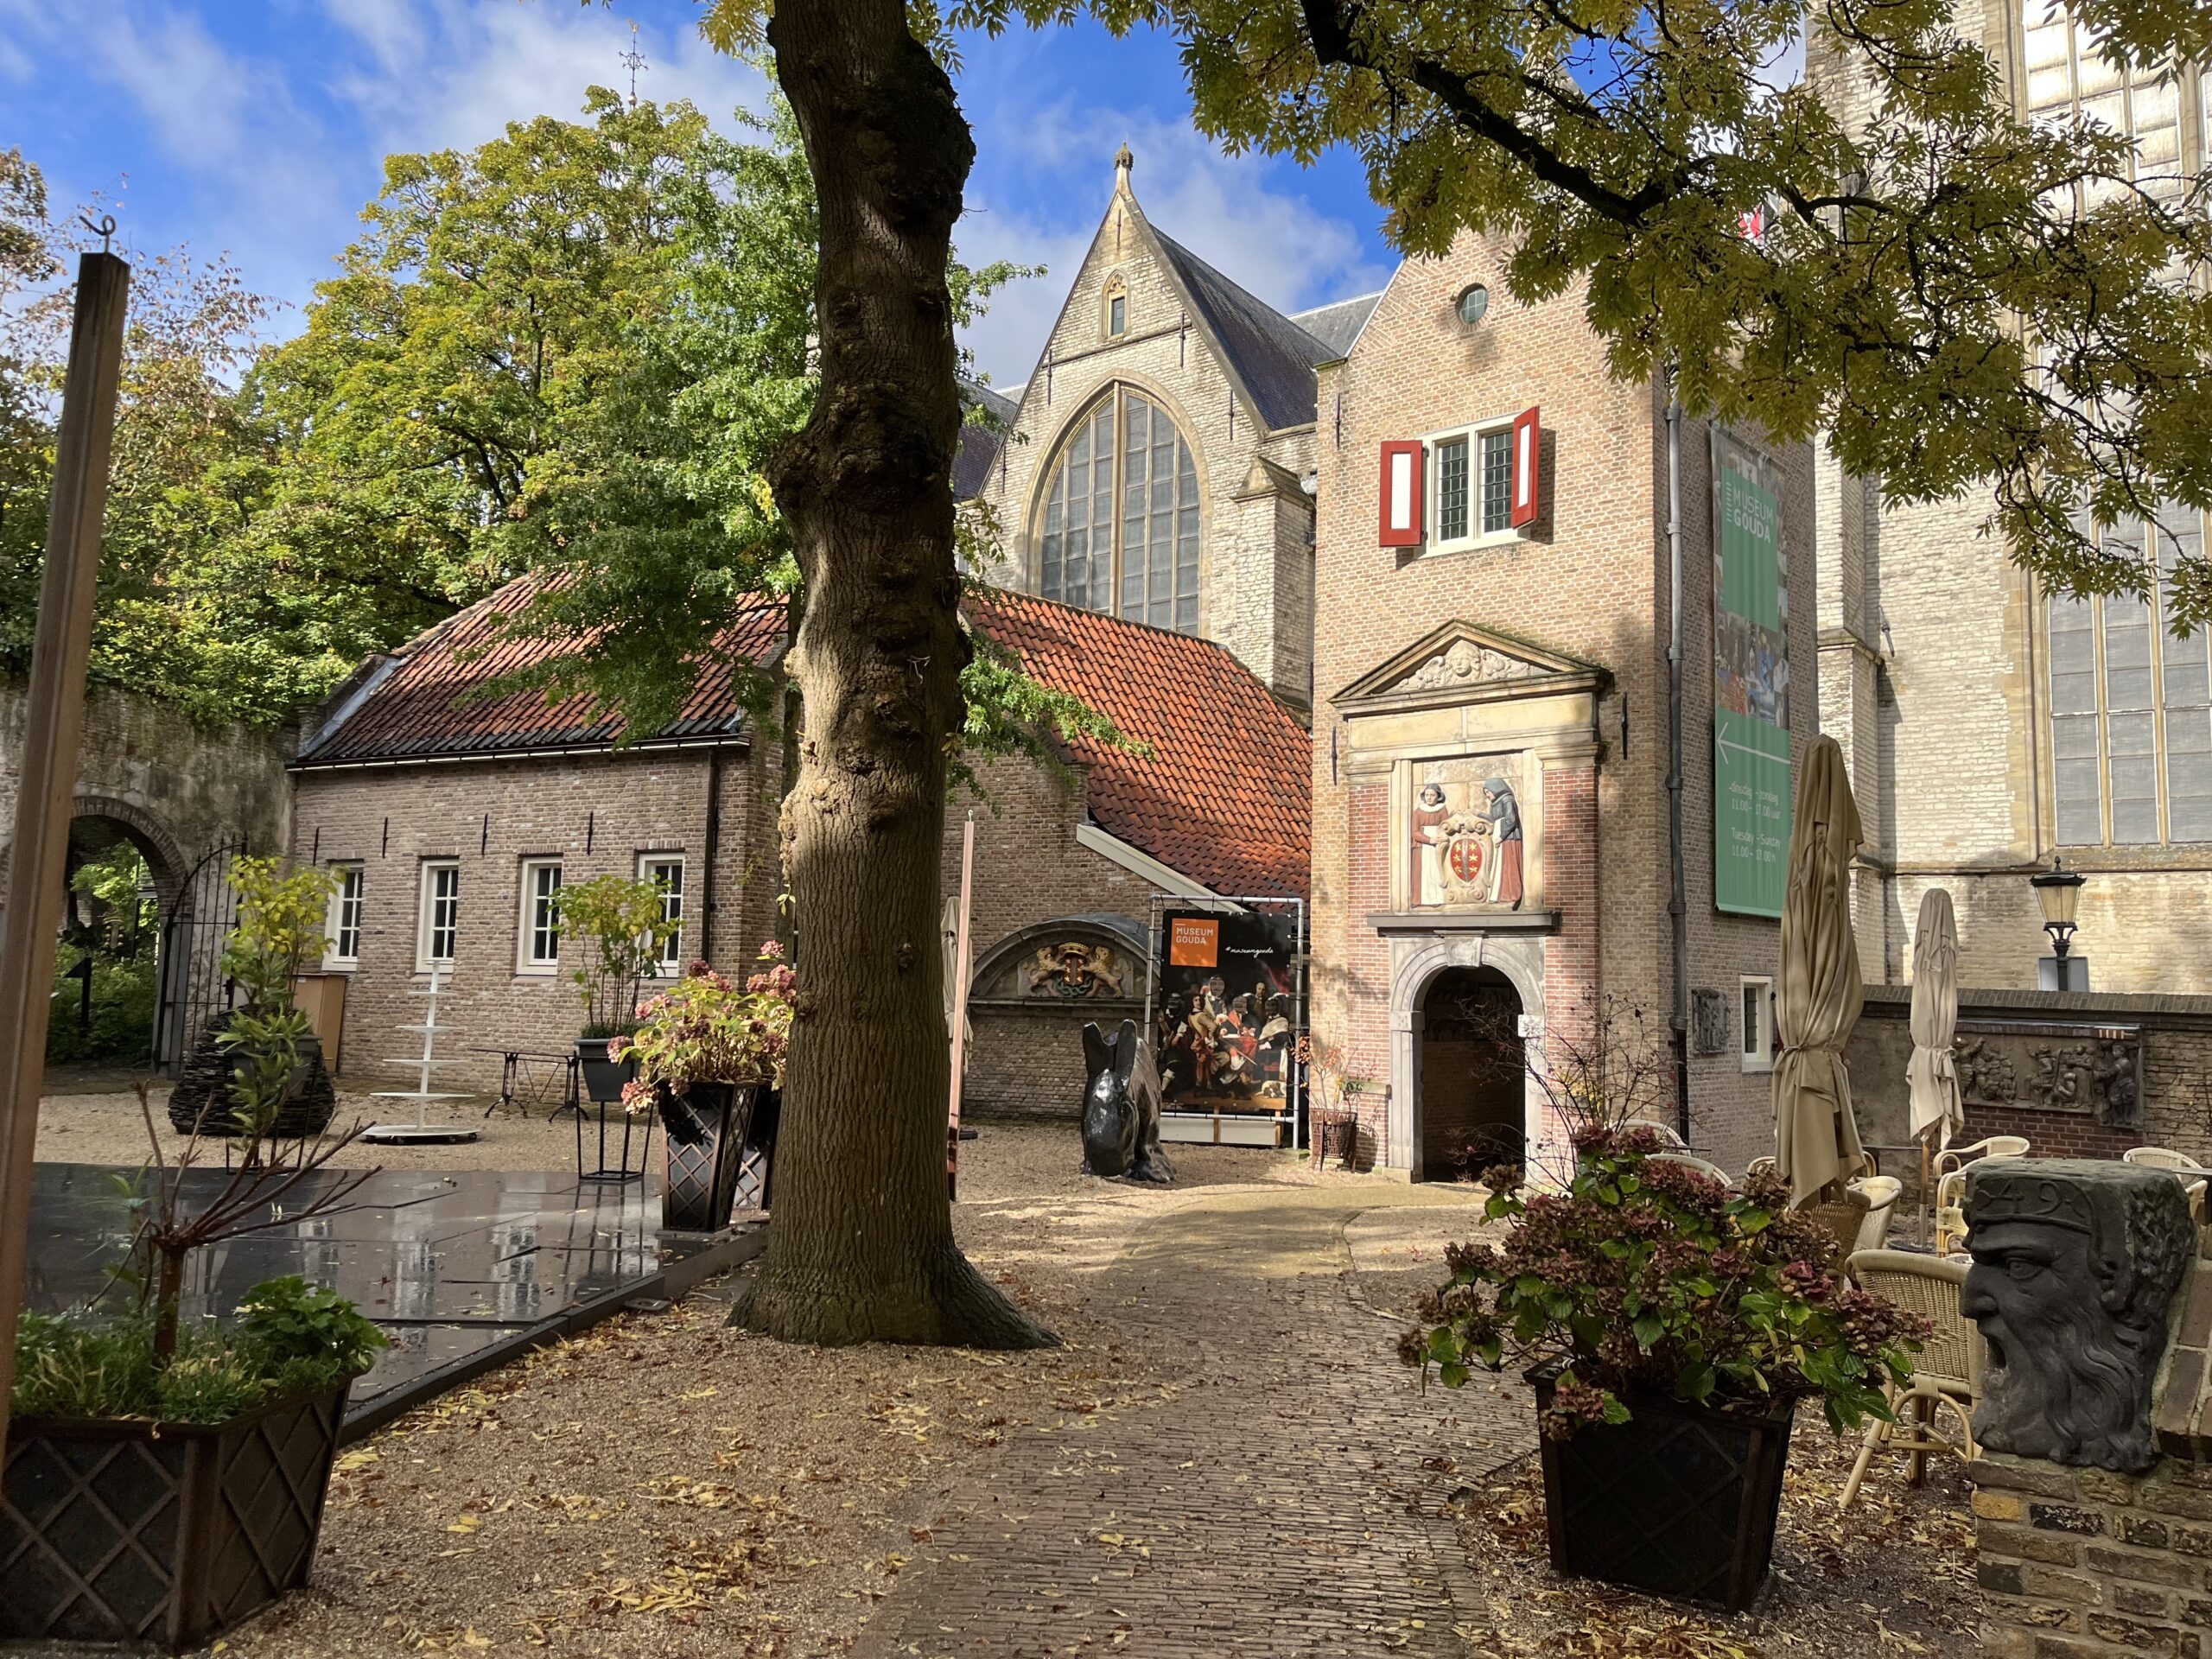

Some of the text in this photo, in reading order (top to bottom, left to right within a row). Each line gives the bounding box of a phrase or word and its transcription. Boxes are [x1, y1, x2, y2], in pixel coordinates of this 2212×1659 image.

[1733, 487, 1773, 525] MUSEUM
[1733, 508, 1770, 543] GOUDA
[1732, 827, 1755, 845] Tuesday
[1759, 833, 1782, 851] Sunday
[1176, 936, 1206, 944] GOUDA
